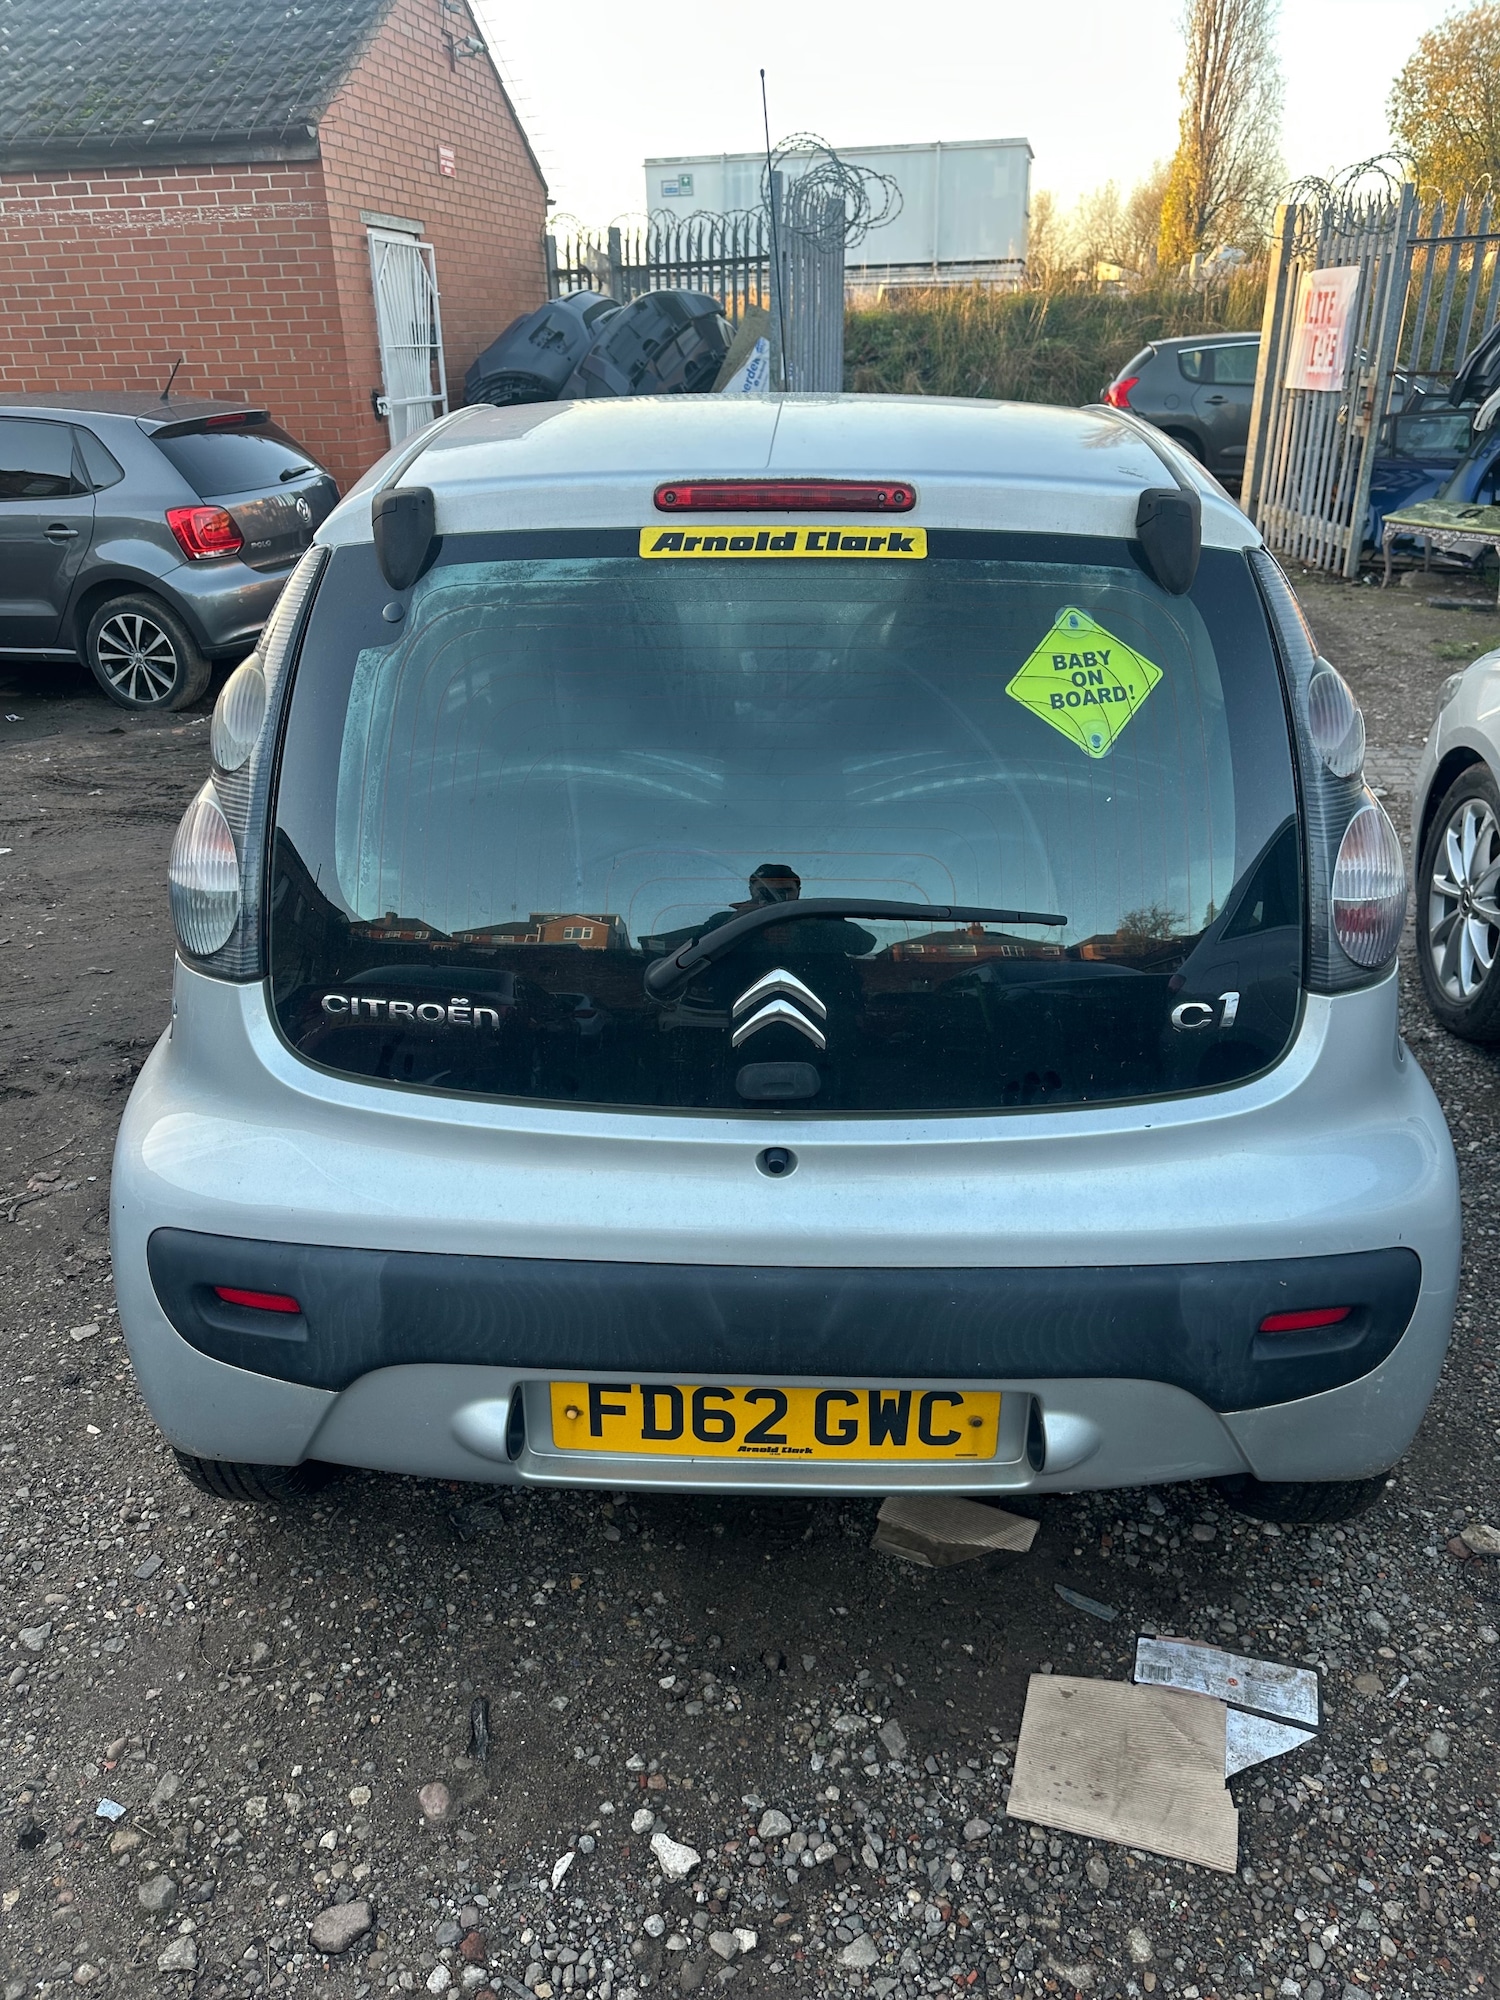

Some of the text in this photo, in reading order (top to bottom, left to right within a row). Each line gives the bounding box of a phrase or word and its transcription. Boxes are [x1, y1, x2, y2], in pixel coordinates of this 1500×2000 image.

[251, 540, 272, 549] POLO
[650, 531, 915, 552] Arnold Clark
[1052, 650, 1112, 671] BABY
[1071, 669, 1104, 688] ON
[1050, 684, 1136, 710] BOARD!
[1171, 991, 1241, 1029] C1
[588, 1383, 965, 1447] FD62 GWC
[737, 1445, 779, 1454] Arnold
[781, 1446, 813, 1454] Clark
